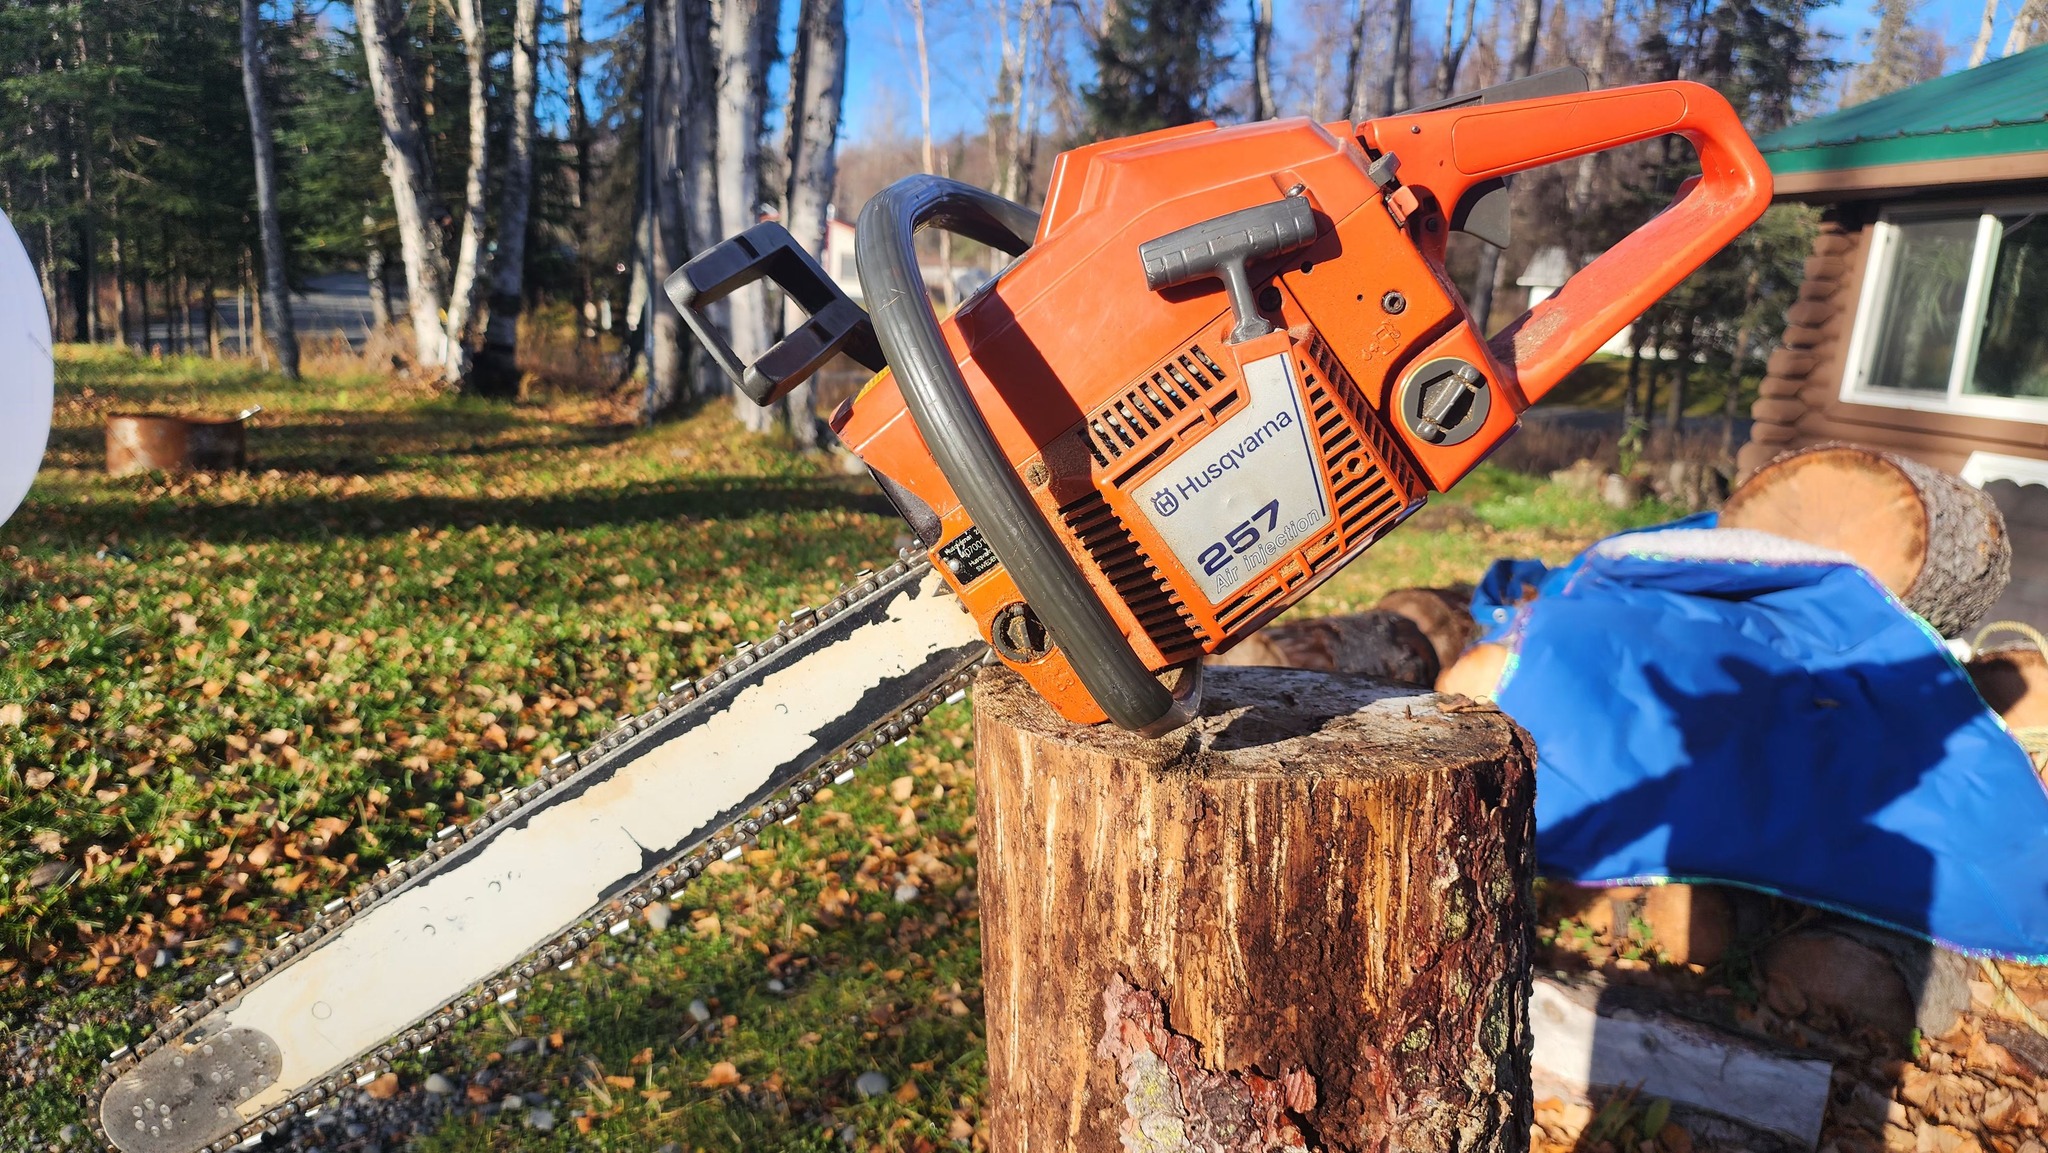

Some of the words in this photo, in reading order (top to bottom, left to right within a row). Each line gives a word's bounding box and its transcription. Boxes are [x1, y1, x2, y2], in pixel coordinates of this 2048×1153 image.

[1176, 411, 1293, 500] Husqvarna
[975, 555, 997, 572] SWEDE
[1197, 498, 1280, 577] 257
[1216, 565, 1240, 594] Air
[1243, 508, 1321, 571] injection
